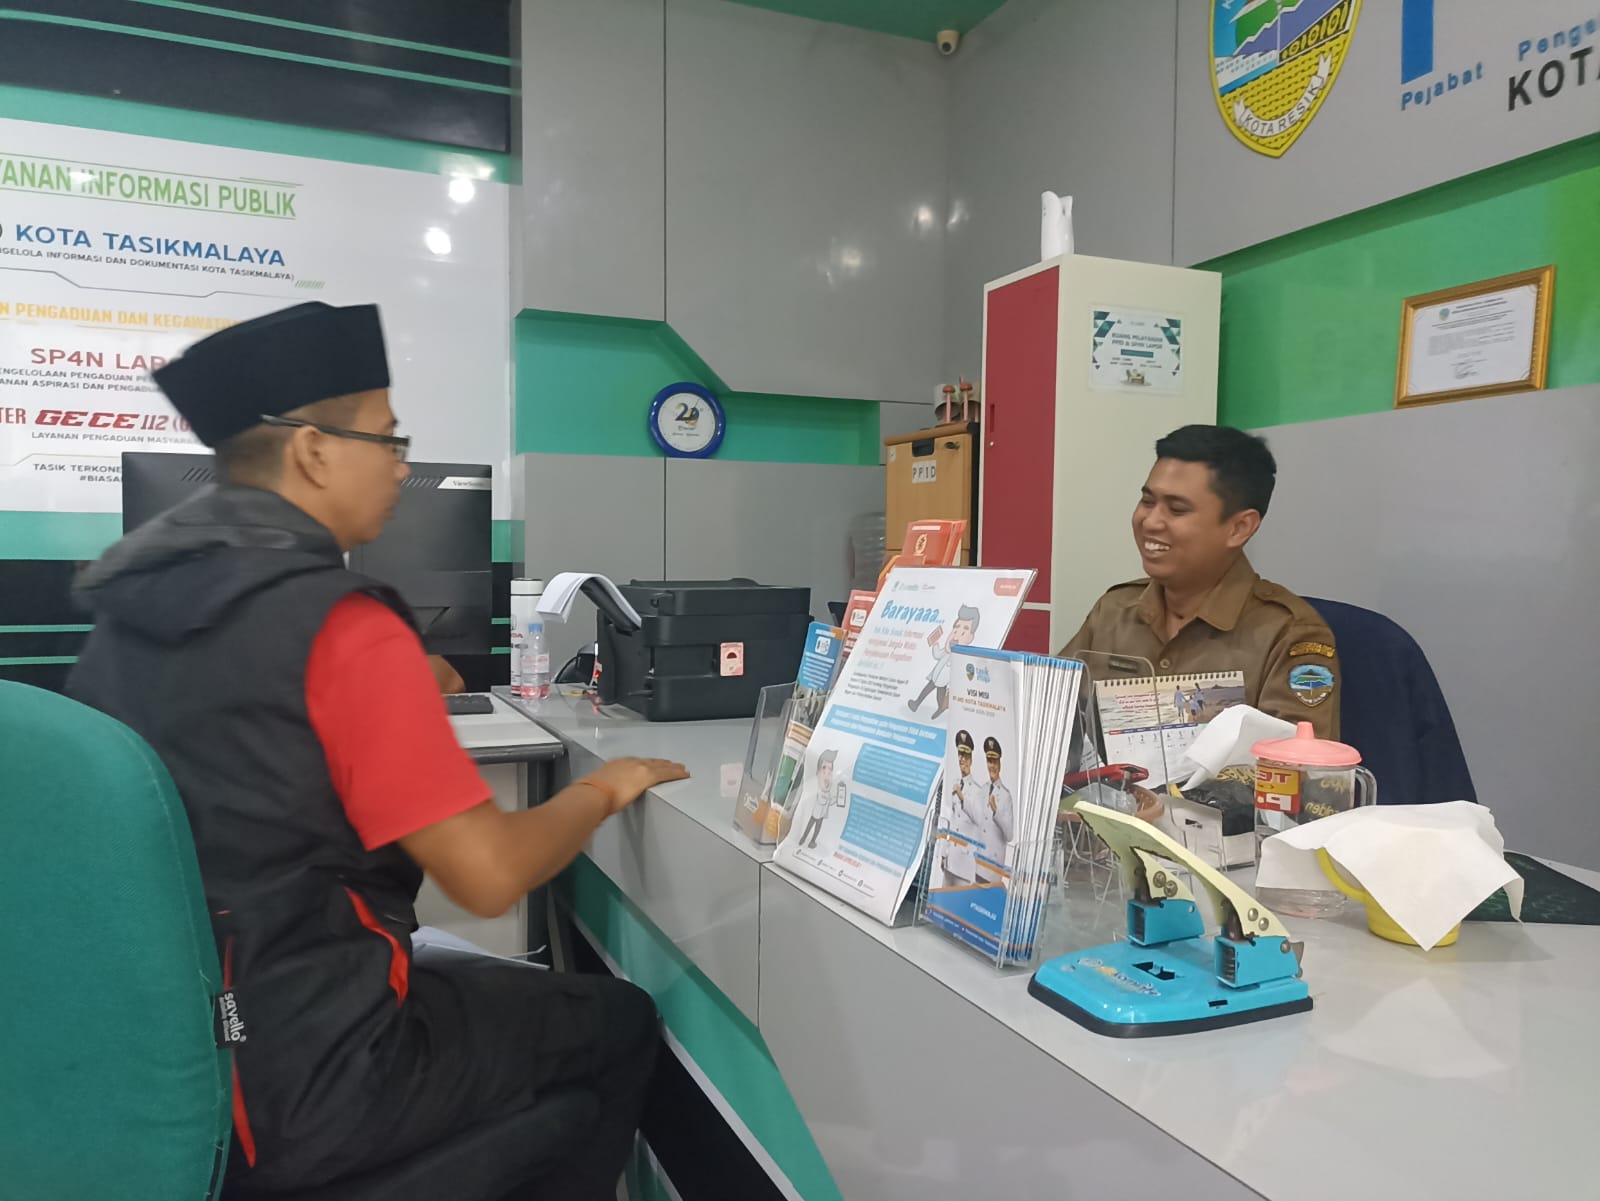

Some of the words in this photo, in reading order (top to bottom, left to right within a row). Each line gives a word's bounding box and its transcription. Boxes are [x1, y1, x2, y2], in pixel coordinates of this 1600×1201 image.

[1402, 62, 1483, 111] Pejabat
[1518, 18, 1600, 61] Penge
[1508, 46, 1600, 111] KOT
[1244, 115, 1275, 134] KOTA
[1279, 84, 1319, 131] RESIK
[0, 159, 71, 192] ANAN
[81, 168, 208, 208] INFORMASI
[219, 185, 296, 217] PUBLIK
[16, 224, 92, 248] KOTA
[103, 232, 285, 266] TASIKMALAYA
[0, 247, 43, 258] GELOLA
[47, 252, 102, 262] INFORMASI
[106, 256, 127, 265] DAN
[130, 259, 198, 271] DOKUMENTASI
[202, 265, 227, 275] KOTA
[16, 303, 113, 322] PENGADUAN
[118, 310, 148, 325] DAN
[30, 348, 104, 368] SP4N
[116, 353, 176, 371] LAP
[32, 379, 79, 389] ASPIRASI
[83, 383, 104, 391] DAN
[71, 371, 133, 382] PENGADUAN
[141, 415, 169, 431] 112
[32, 431, 79, 440] LAYANAN
[83, 434, 144, 443] PENGADUAN
[34, 463, 66, 472] TASIK
[224, 992, 245, 1042] savello
